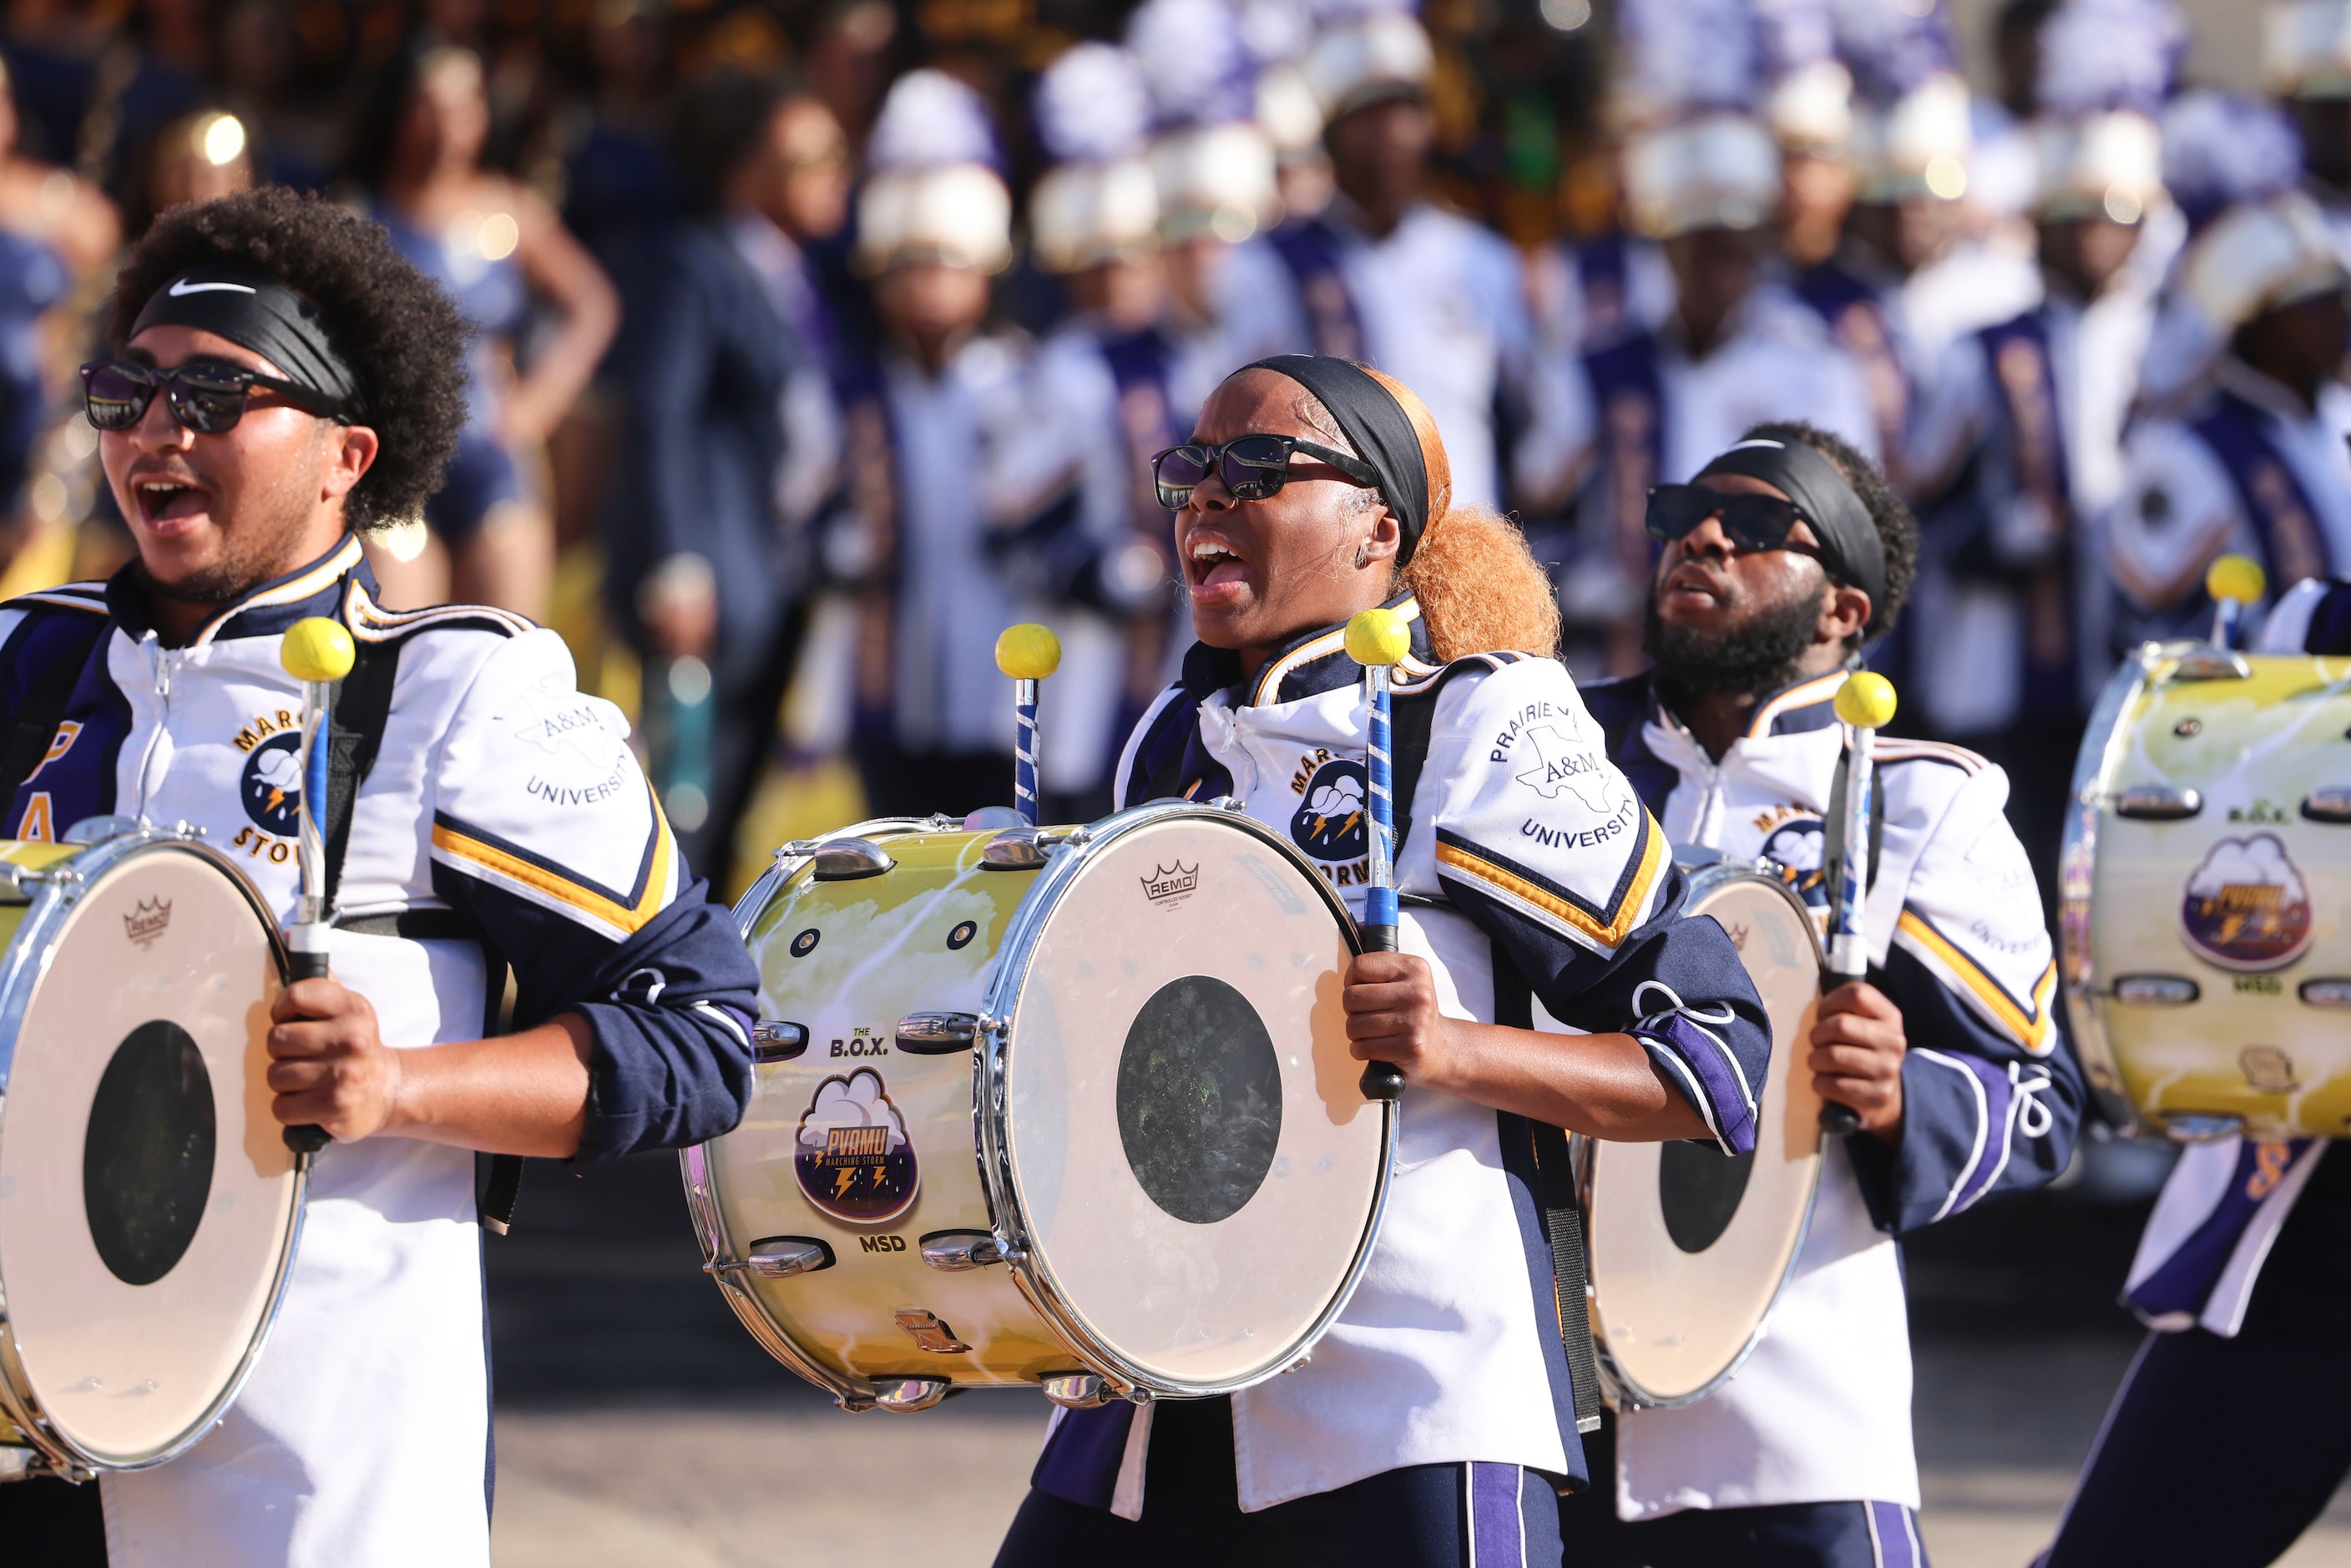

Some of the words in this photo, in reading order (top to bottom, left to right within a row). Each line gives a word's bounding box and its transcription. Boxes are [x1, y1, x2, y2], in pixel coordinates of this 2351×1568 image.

[544, 706, 599, 737] A&M
[1489, 701, 1553, 763] PRAIRIE
[1545, 751, 1600, 784] A&M
[1522, 794, 1636, 849] UNIVERSITY
[1150, 875, 1192, 896] REMO
[853, 1027, 871, 1036] THE
[830, 1037, 888, 1058] B.O.X.
[827, 1128, 887, 1156] PVAMU
[825, 1156, 861, 1167] MARCHING
[862, 1156, 885, 1166] STORM
[858, 1235, 908, 1253] MSD
